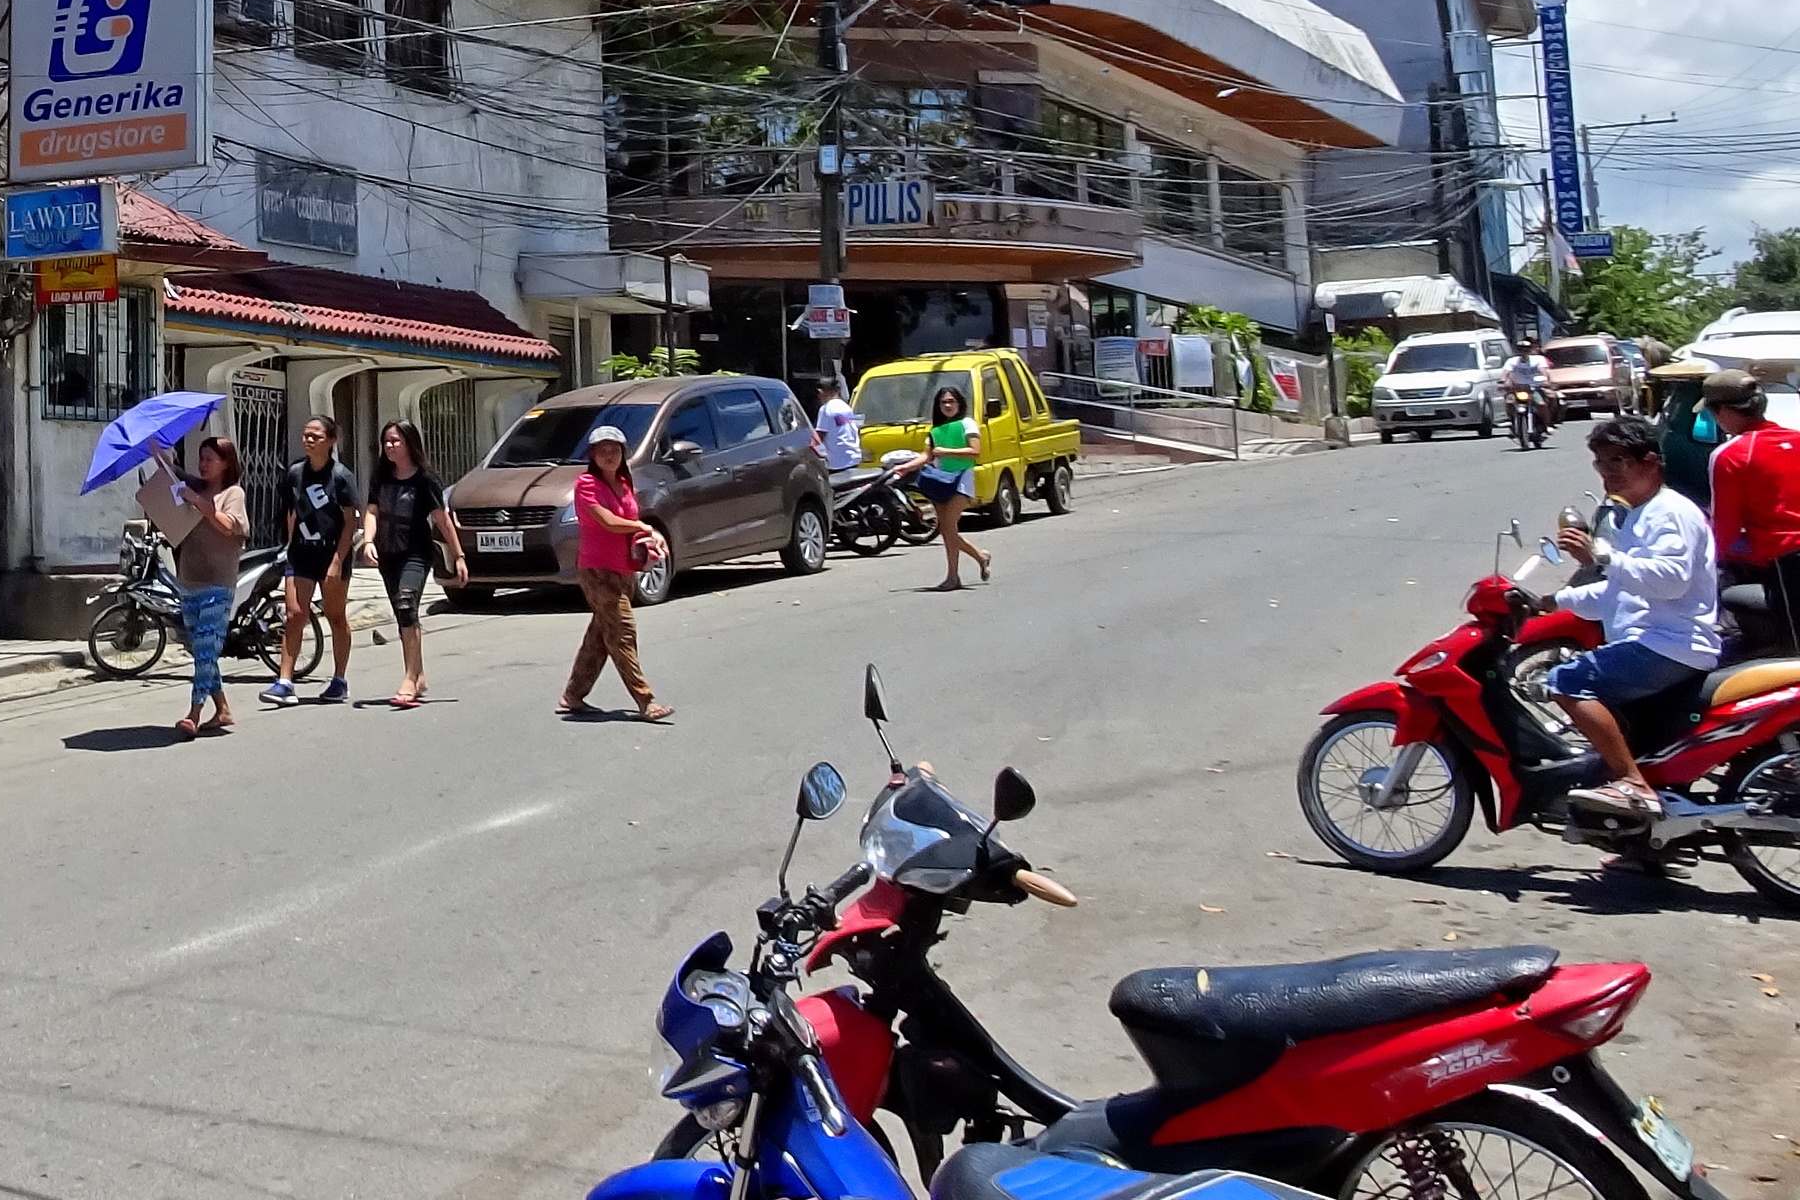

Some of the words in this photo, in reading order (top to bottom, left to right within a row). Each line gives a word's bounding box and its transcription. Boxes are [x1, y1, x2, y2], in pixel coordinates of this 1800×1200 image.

[22, 80, 185, 123] Generika
[37, 122, 167, 158] drugstore
[9, 201, 100, 233] LAWYER
[849, 180, 923, 227] PULIS
[246, 387, 284, 401] OFFICE
